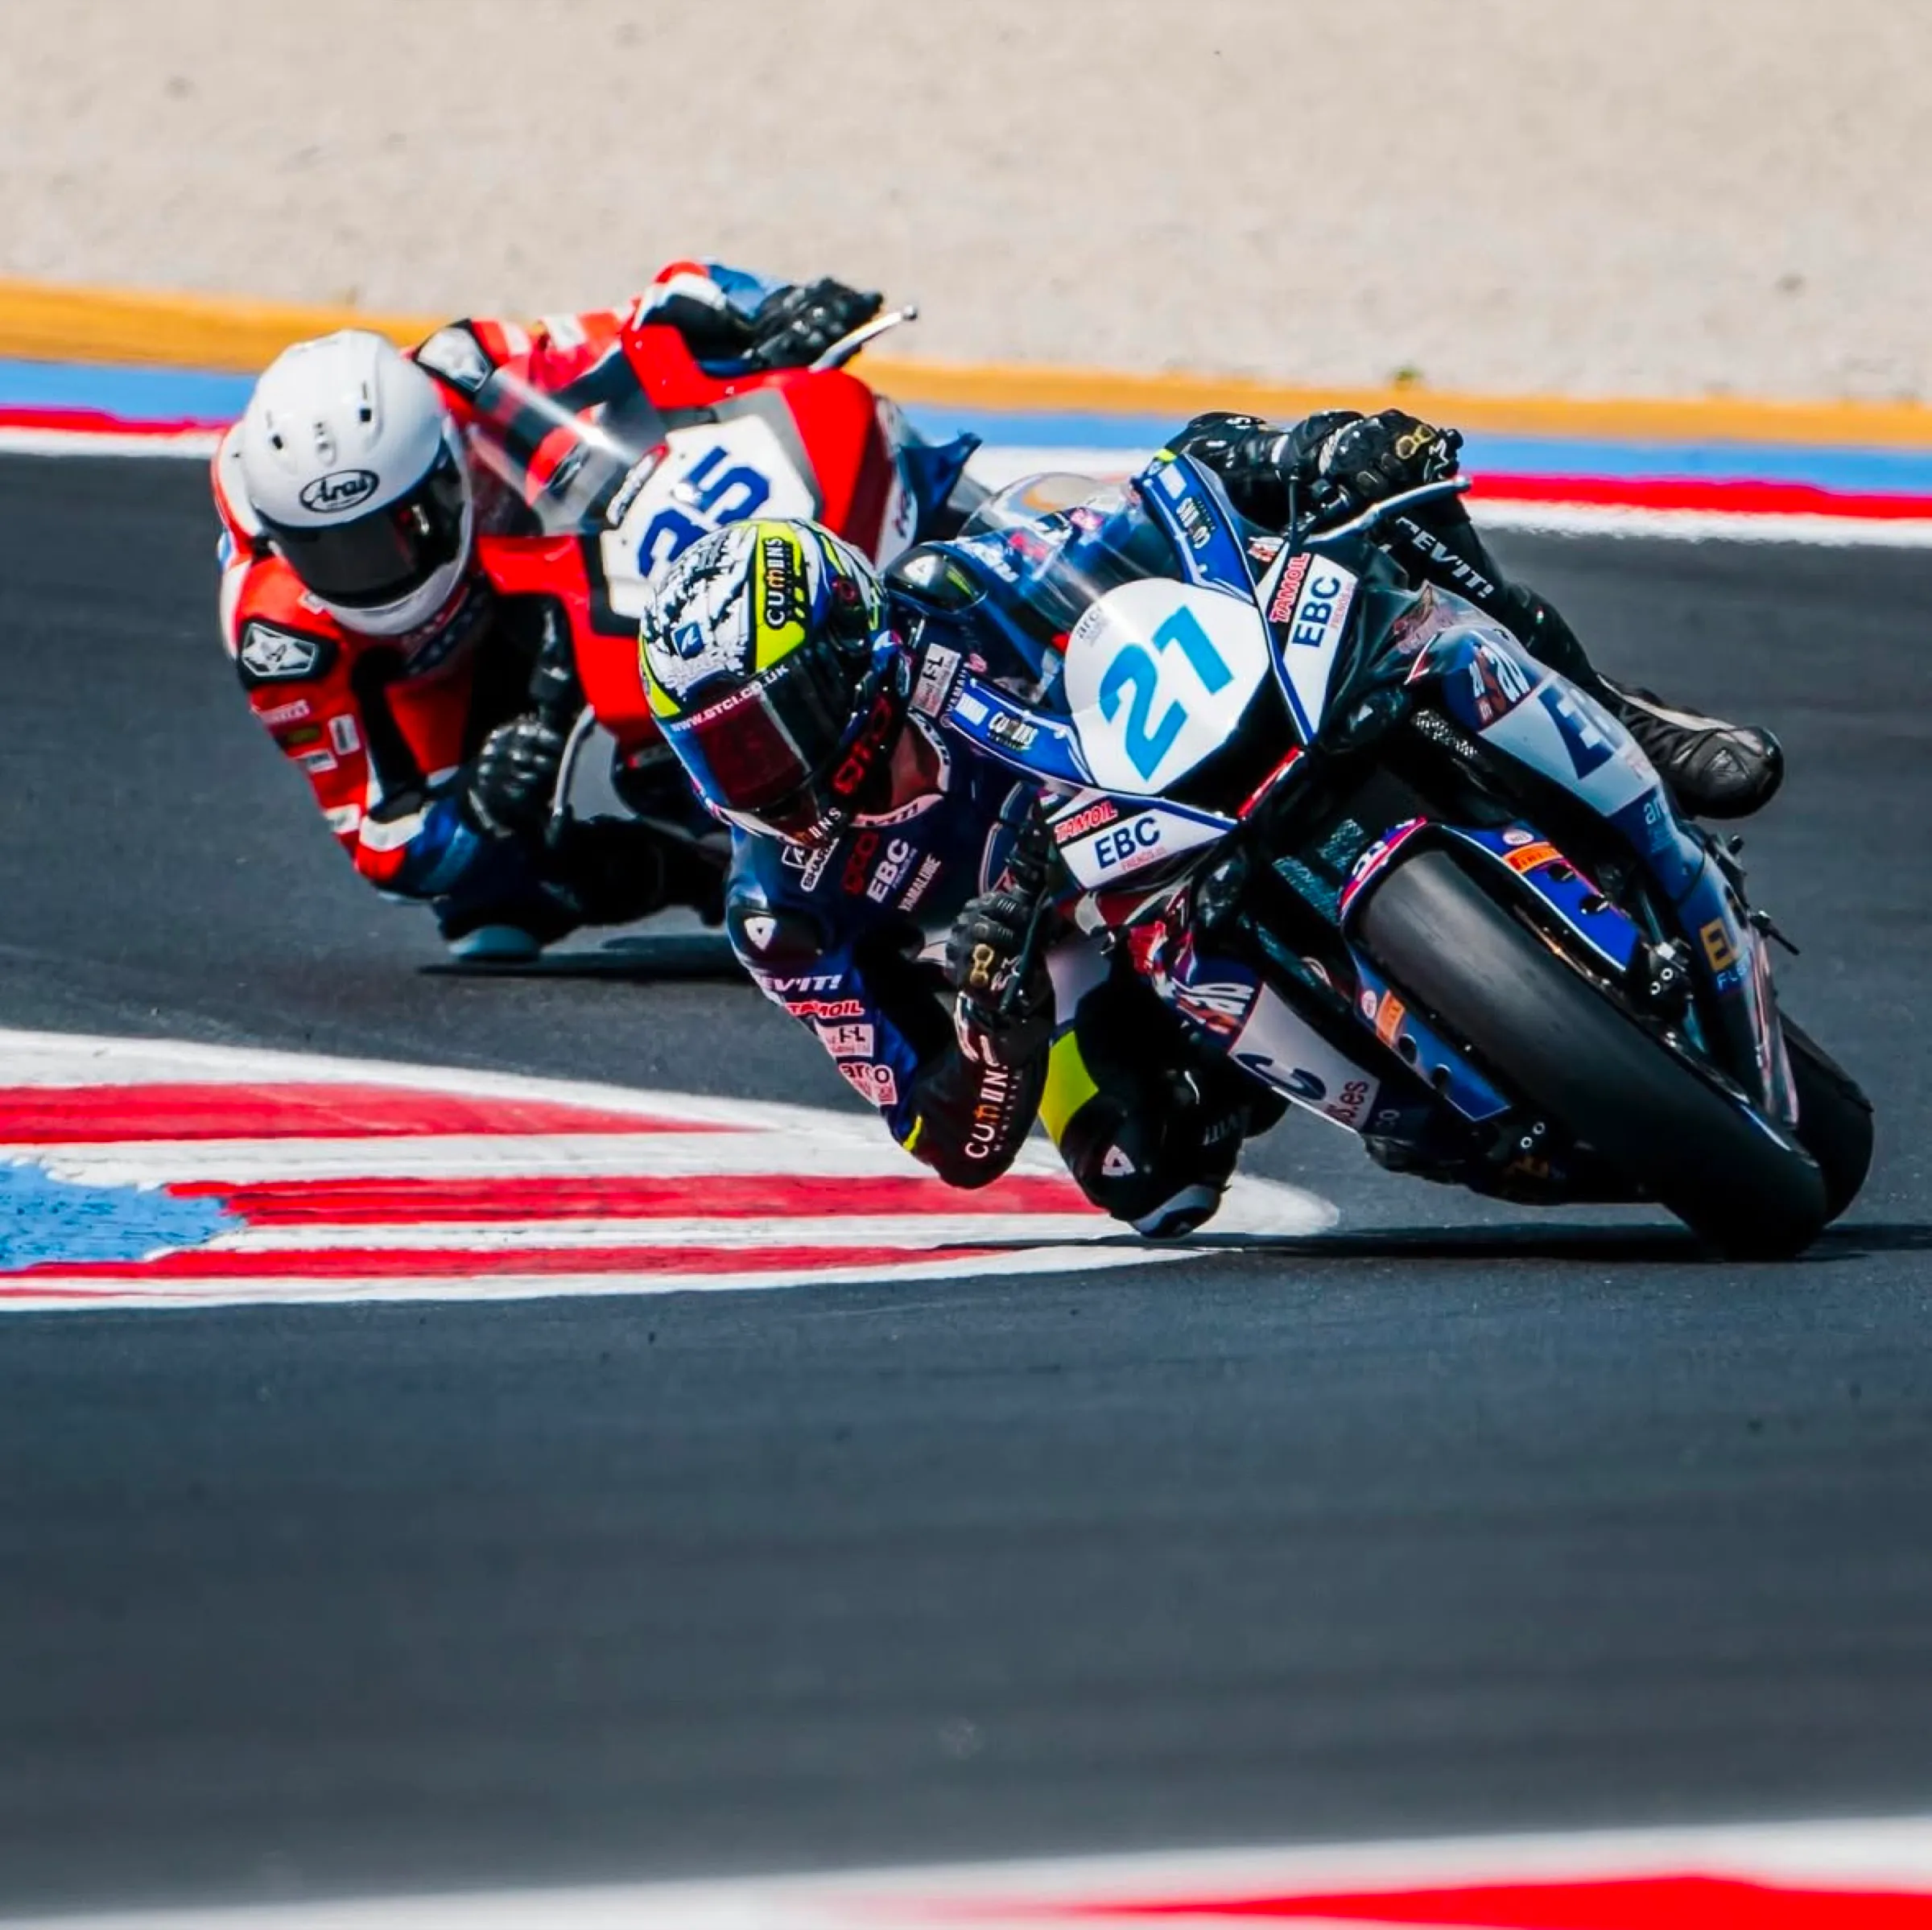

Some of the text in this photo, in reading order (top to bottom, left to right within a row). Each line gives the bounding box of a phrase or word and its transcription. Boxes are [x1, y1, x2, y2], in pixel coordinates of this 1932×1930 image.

[312, 473, 369, 507] Arai
[1269, 552, 1311, 623] TAMOIL
[1292, 576, 1341, 647] EBC
[1100, 605, 1233, 780] 21
[1054, 800, 1118, 844] TAMOIL
[1094, 817, 1161, 869] EBC
[866, 839, 910, 904] EBC
